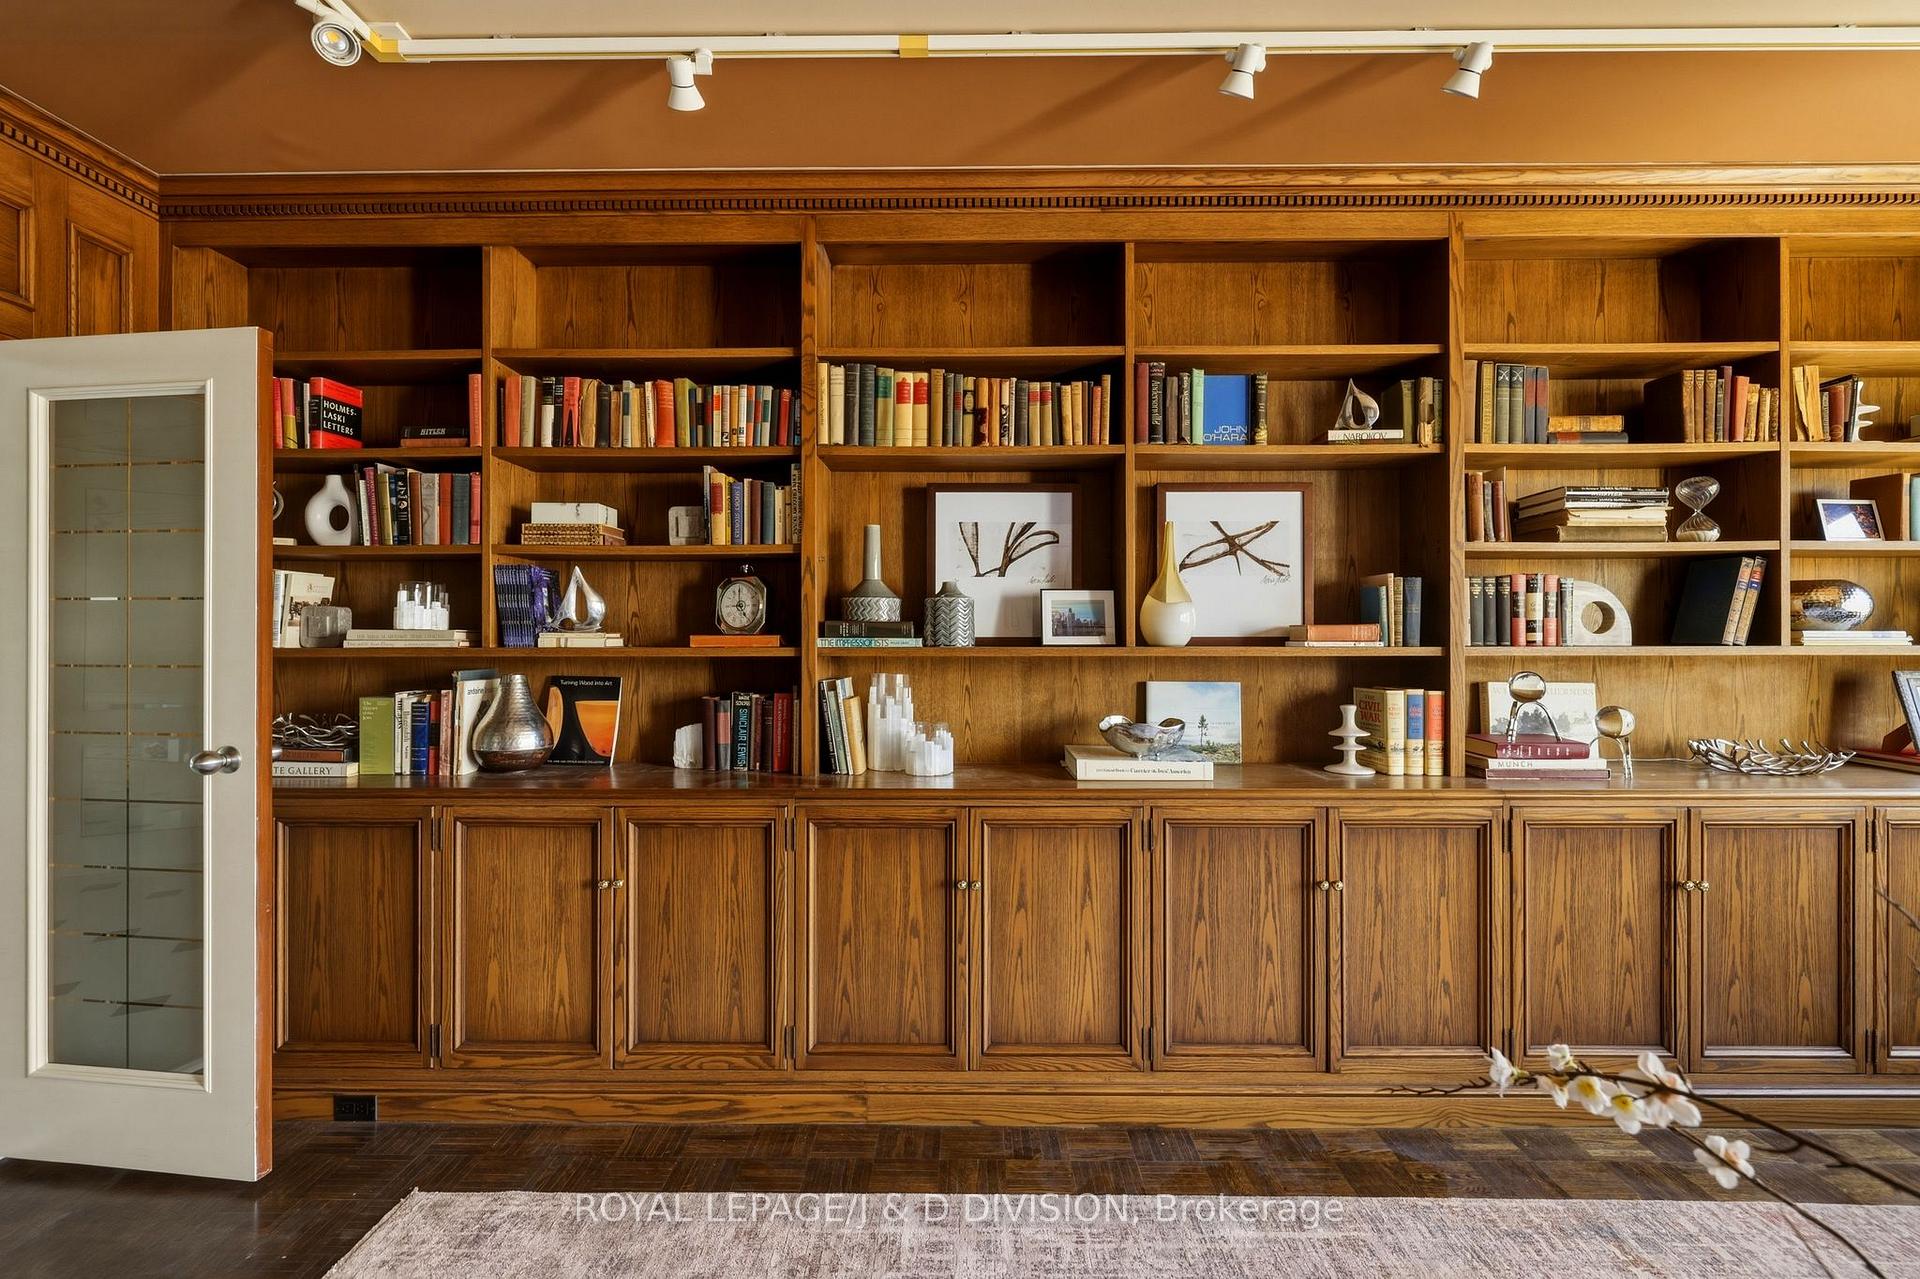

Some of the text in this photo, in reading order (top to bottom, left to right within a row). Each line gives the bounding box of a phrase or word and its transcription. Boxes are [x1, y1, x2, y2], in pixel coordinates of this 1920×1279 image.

[1151, 379, 1162, 425] Andersonville
[323, 410, 345, 423] LASKI
[323, 420, 353, 436] LETTERS
[1214, 425, 1248, 434] JOHN
[1203, 433, 1248, 442] O'HARA
[1343, 432, 1387, 441] NABOKOV
[1358, 701, 1382, 712] CIVIL
[1360, 710, 1382, 723] WAR
[738, 708, 748, 740] SINCLAIR
[737, 743, 747, 765] LEWIS
[273, 766, 334, 776] TE GALLERY
